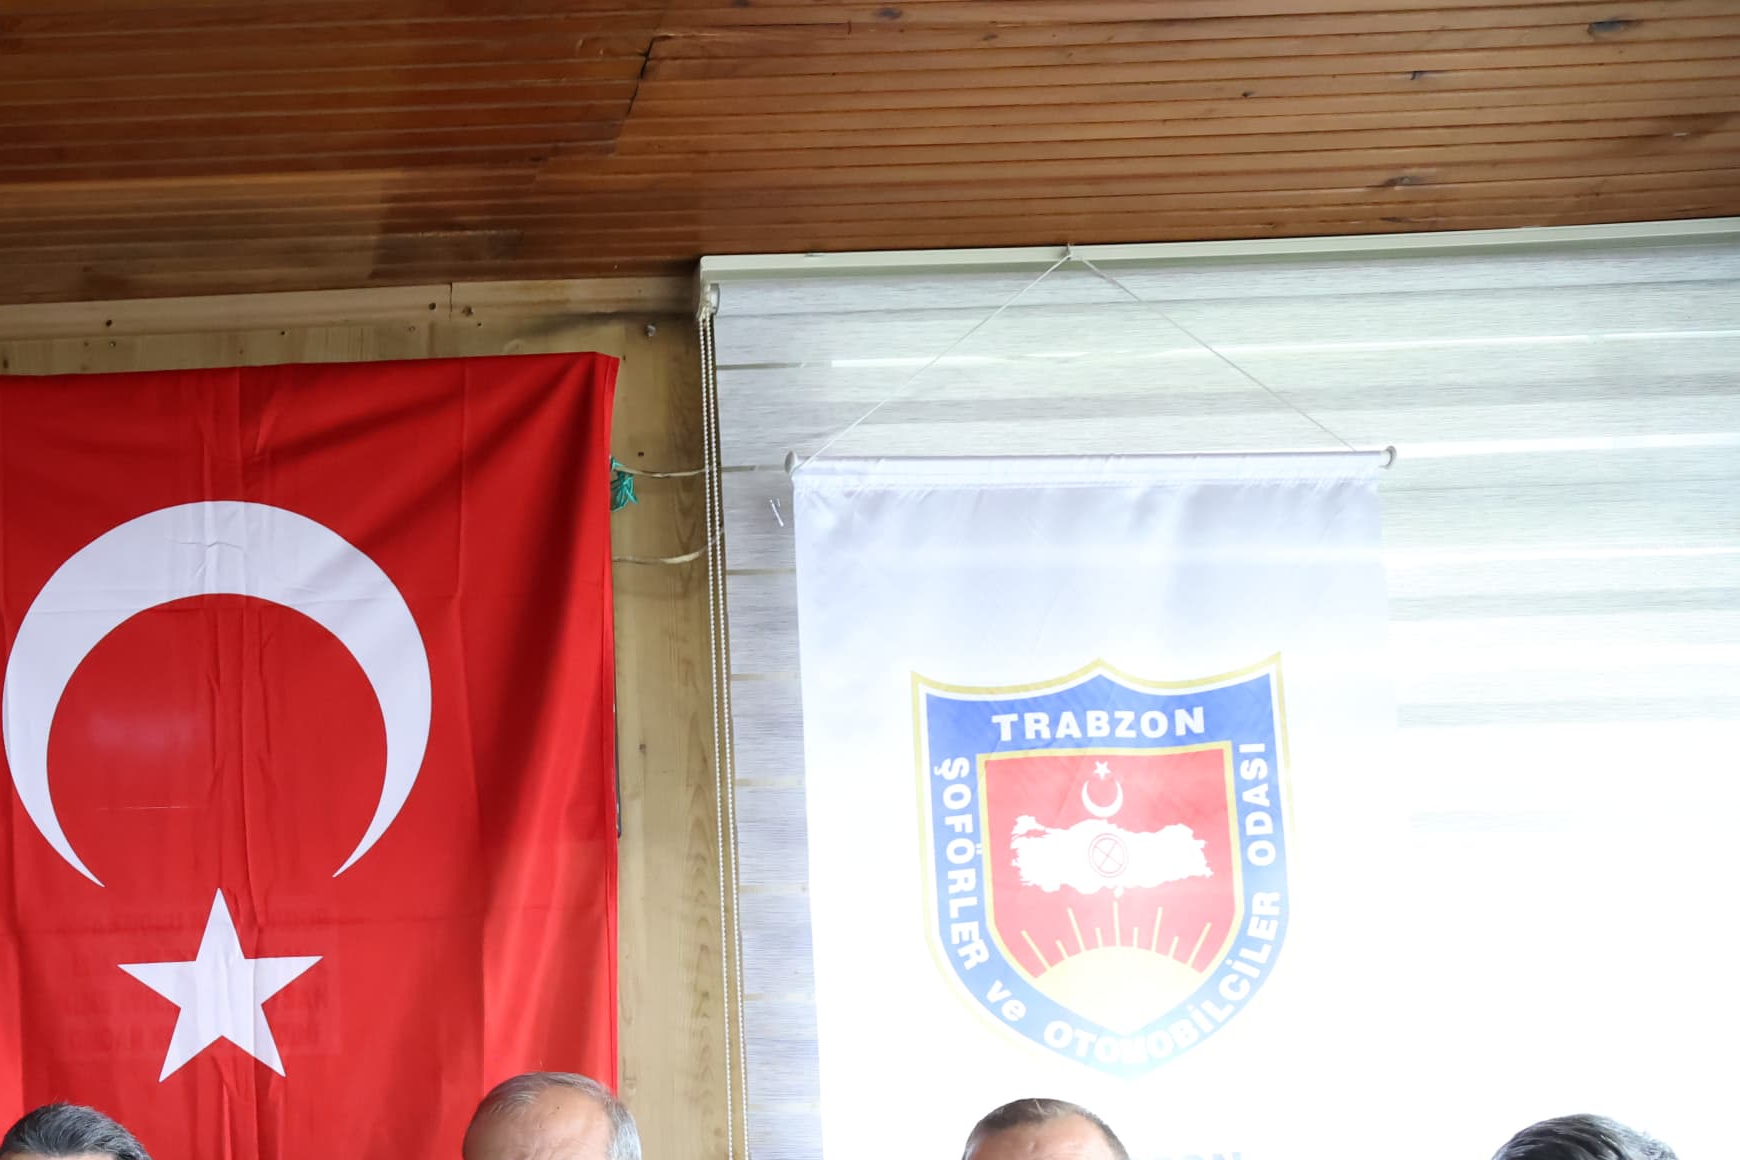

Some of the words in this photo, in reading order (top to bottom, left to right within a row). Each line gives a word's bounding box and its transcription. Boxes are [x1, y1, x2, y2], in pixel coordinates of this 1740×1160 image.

[991, 706, 1205, 742] TRABZON
[934, 756, 990, 971] ŞOFÖRLER
[987, 980, 1027, 1023] ve
[1043, 891, 1281, 1065] OTOMOBİLCİLER
[1240, 743, 1277, 867] ODASI
